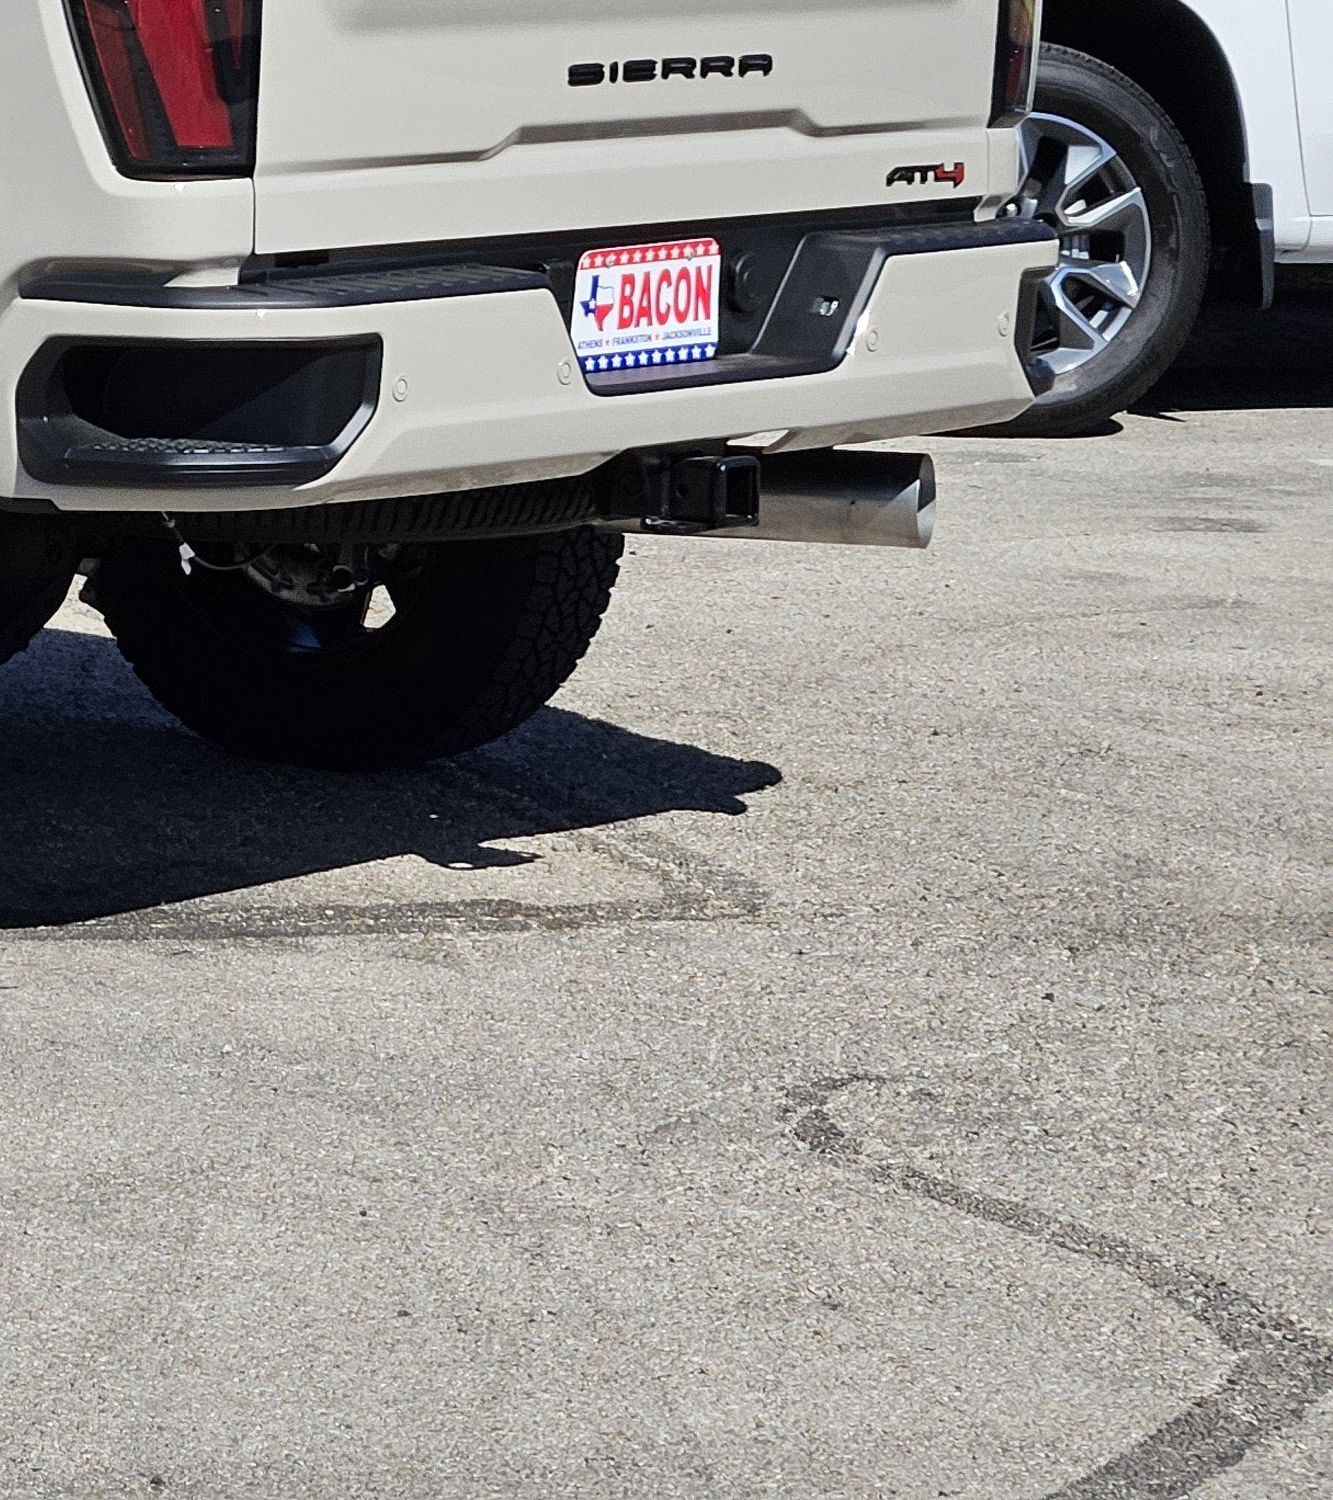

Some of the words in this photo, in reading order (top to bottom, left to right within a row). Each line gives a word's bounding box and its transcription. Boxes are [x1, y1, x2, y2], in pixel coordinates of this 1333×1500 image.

[567, 53, 773, 87] SIERRA
[886, 162, 964, 189] AT4
[616, 264, 713, 330] BACON
[577, 338, 604, 349] ATHENS
[612, 334, 652, 347] FRANKSTON
[661, 326, 712, 341] JACKSONVILLE
